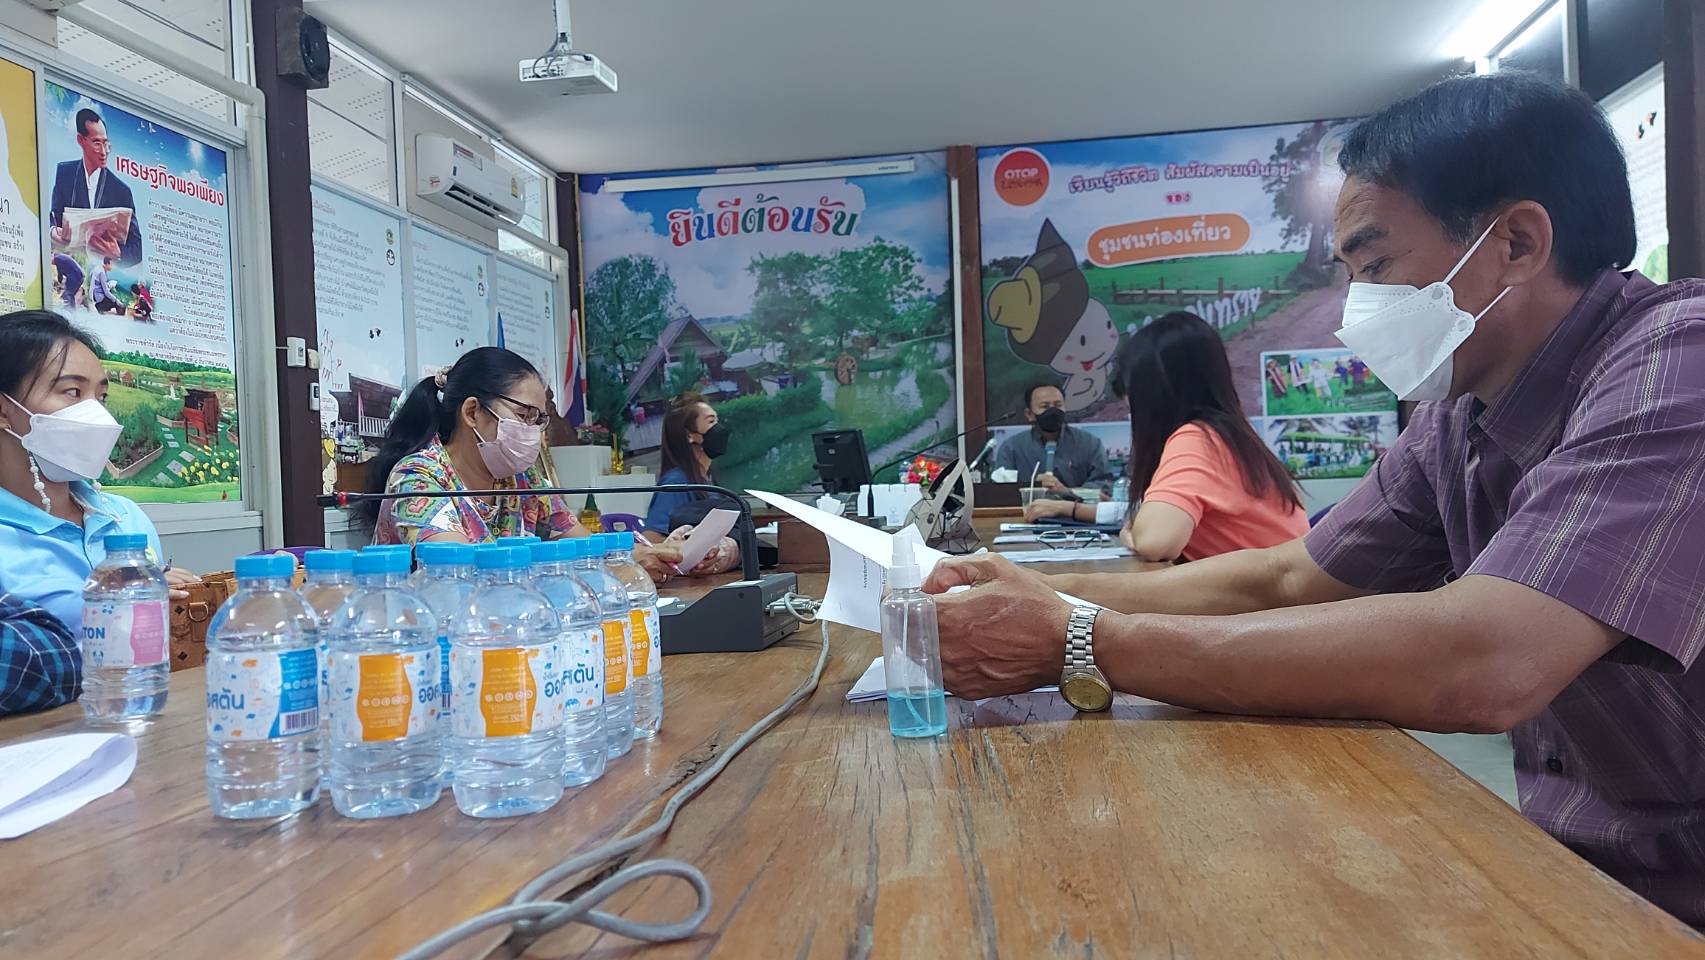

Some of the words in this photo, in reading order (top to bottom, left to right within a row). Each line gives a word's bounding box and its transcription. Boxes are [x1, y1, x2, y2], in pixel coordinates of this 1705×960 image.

[115, 155, 225, 208] เศรษฐกิจพอเพียง
[1004, 167, 1039, 179] OTOP
[668, 192, 858, 248] ยินดีต้อนรับ
[1098, 216, 1232, 263] ชุมชนท่องเที่ยว
